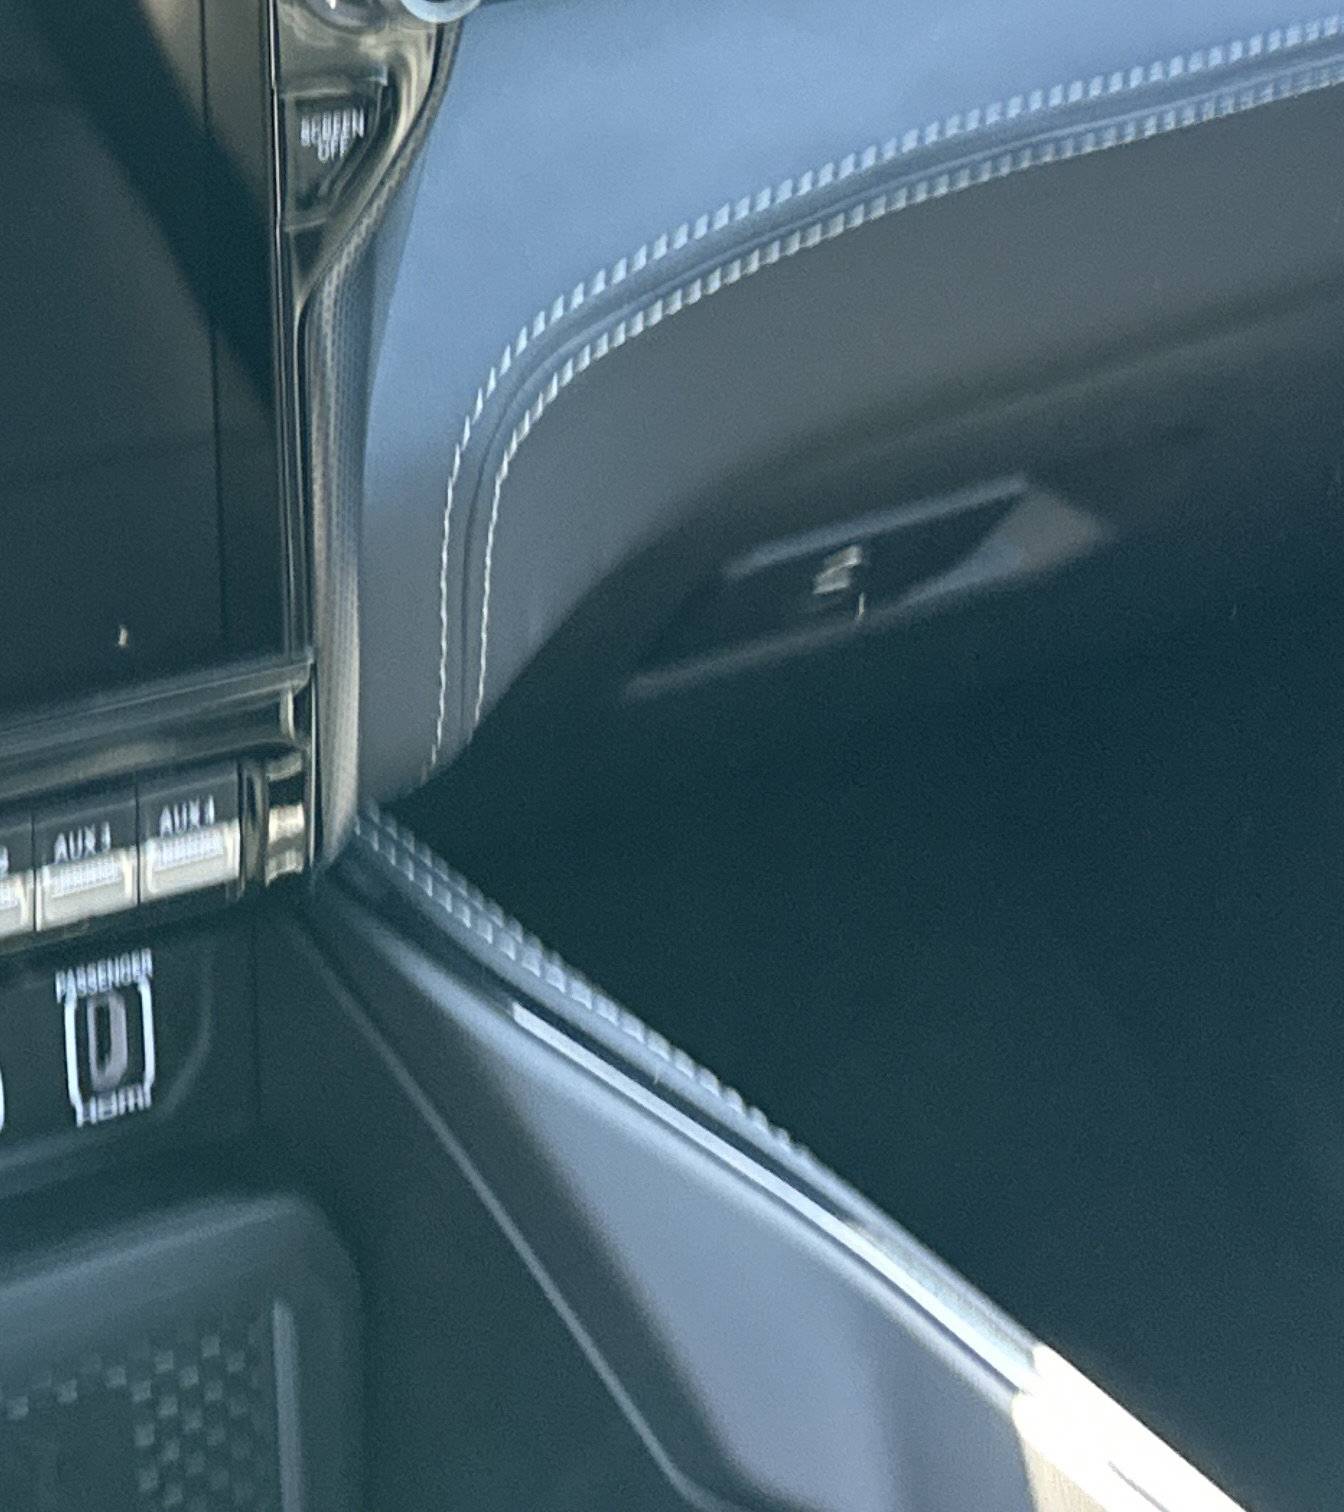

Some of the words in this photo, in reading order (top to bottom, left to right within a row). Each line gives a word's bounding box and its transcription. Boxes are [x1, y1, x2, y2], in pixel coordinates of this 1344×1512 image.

[300, 107, 365, 148] SCREEN
[158, 797, 202, 837] AUX
[54, 824, 96, 865] AUX
[55, 947, 153, 1004] PASSENGER
